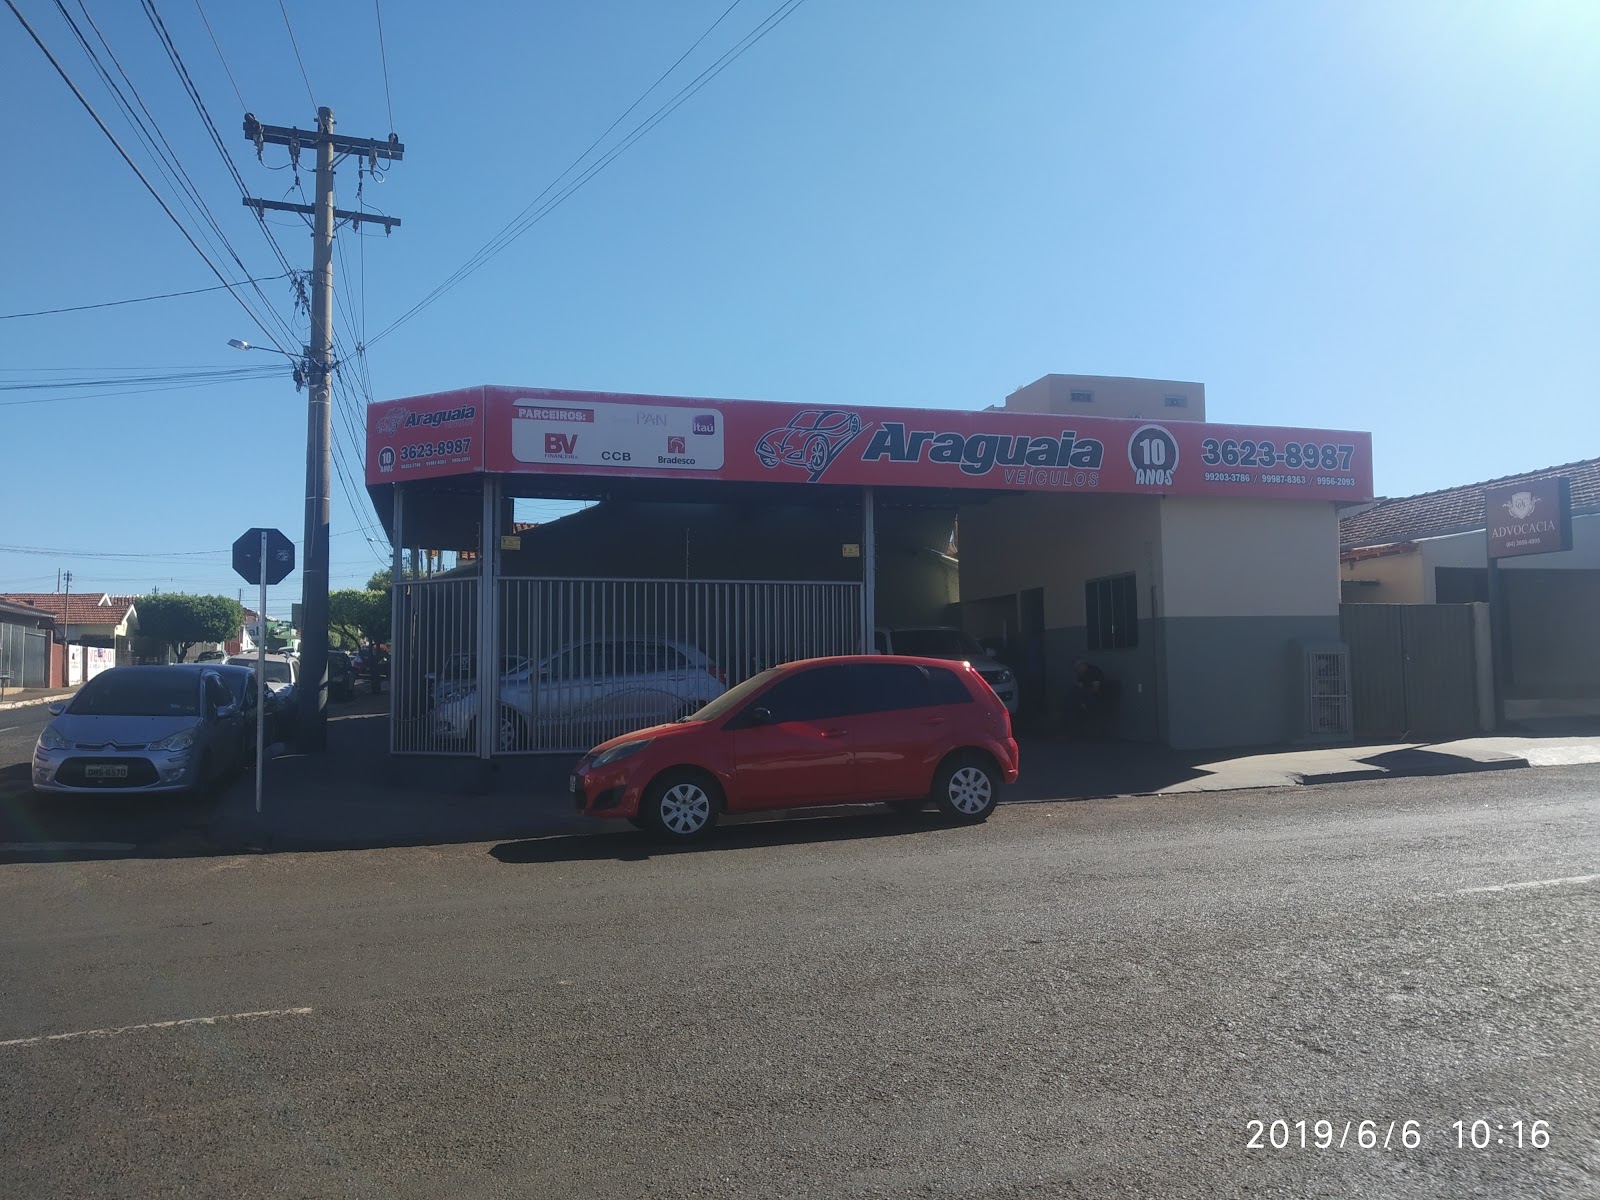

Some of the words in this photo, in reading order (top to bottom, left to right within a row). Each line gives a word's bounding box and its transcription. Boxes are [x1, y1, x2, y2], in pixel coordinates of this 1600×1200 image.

[403, 405, 476, 428] Araguaia
[518, 408, 586, 421] PARCEIROS:
[636, 411, 667, 426] PAN
[693, 422, 714, 433] Itaú
[400, 437, 472, 461] 3623-8987
[544, 432, 579, 455] BV
[860, 422, 1104, 476] Araguaia
[1139, 438, 1166, 466] 10
[381, 452, 391, 465] 10
[601, 451, 631, 461] CCB
[657, 455, 696, 465] Bradesco
[1201, 438, 1355, 471] 3623-8987
[1003, 466, 1099, 486] VEÍCULOS
[1136, 467, 1174, 486] ANOS
[1491, 520, 1555, 538] ADVOCACIA
